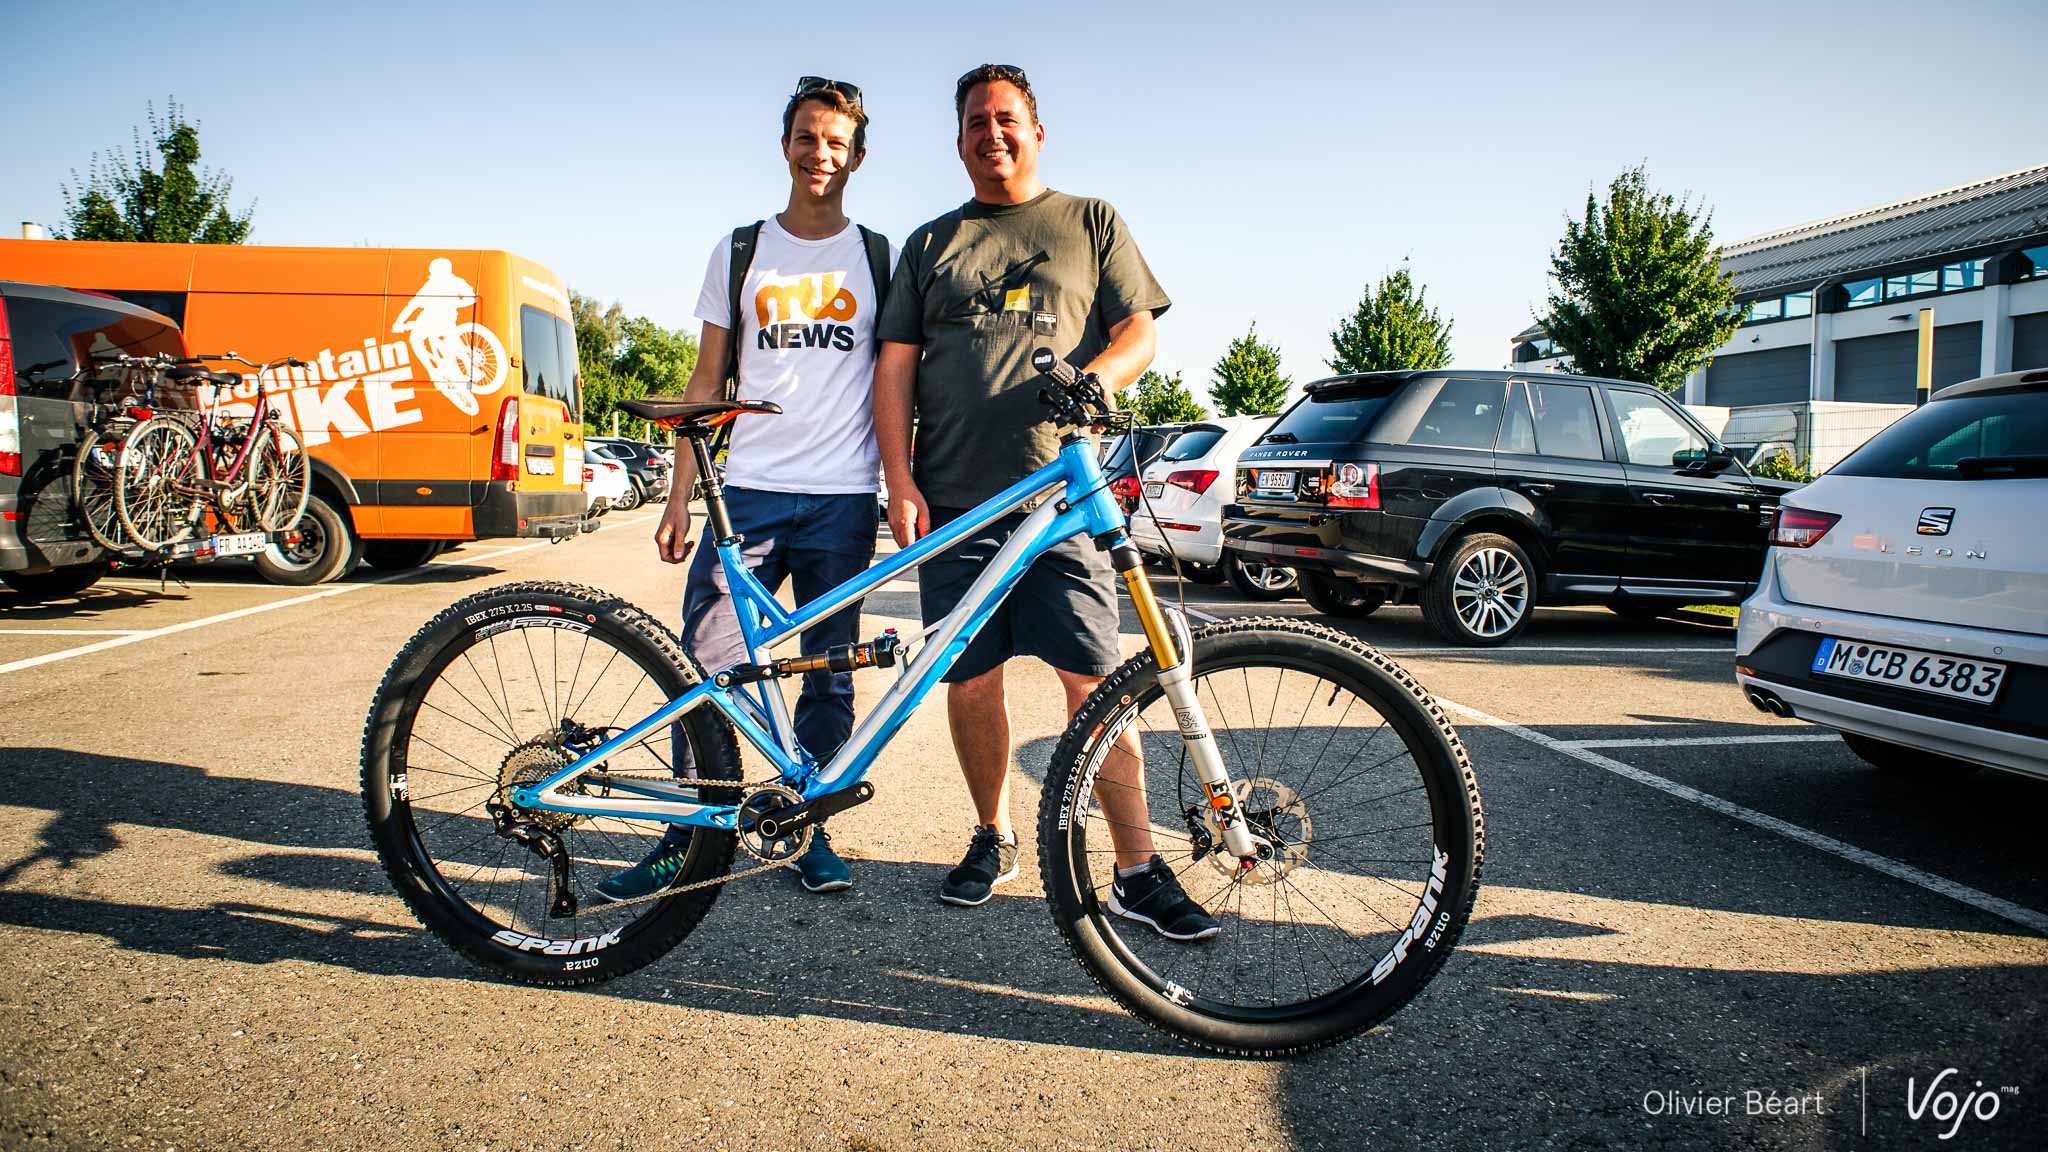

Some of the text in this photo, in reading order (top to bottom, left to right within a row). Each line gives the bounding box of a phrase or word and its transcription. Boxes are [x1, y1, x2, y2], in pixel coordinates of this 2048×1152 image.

[757, 323, 855, 352] NEWS
[464, 610, 489, 626] IBEX
[1817, 657, 1825, 666] D
[1828, 643, 2002, 697] M CB 6383
[793, 810, 809, 822] XT
[1058, 803, 1070, 830] IBEX
